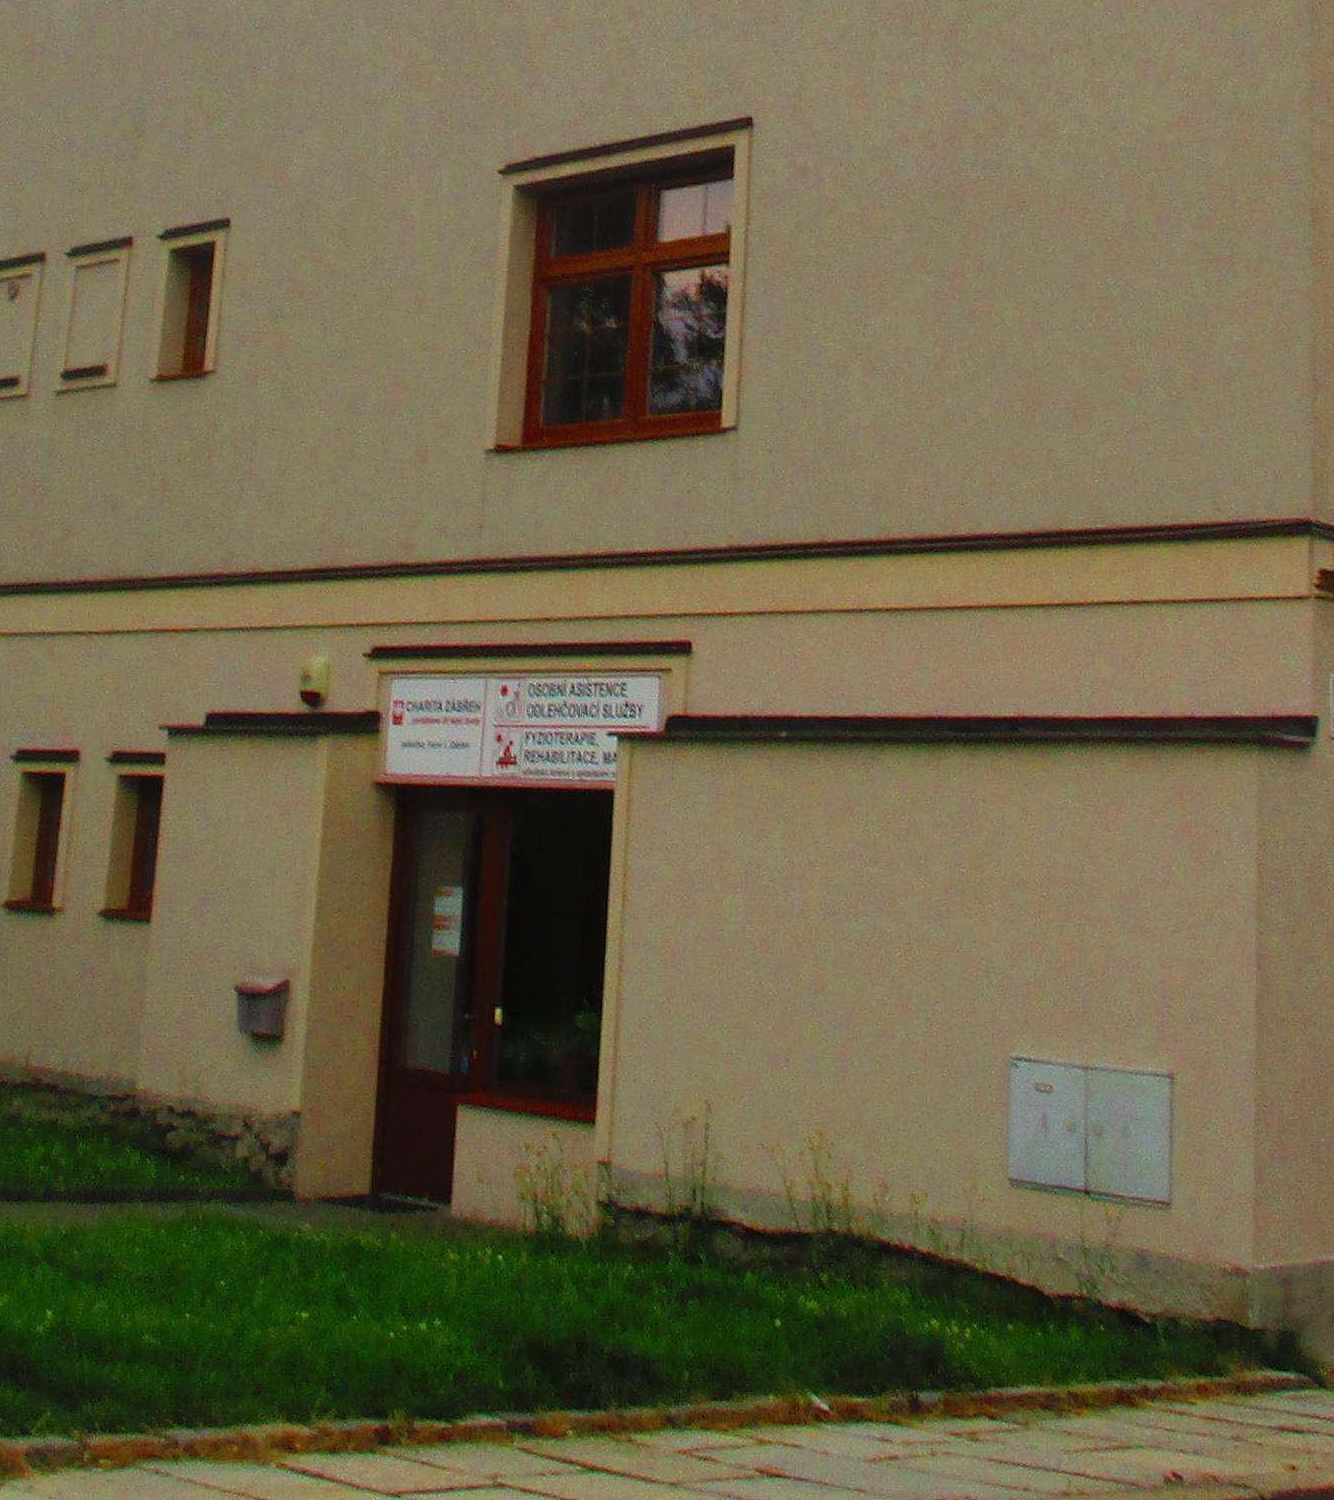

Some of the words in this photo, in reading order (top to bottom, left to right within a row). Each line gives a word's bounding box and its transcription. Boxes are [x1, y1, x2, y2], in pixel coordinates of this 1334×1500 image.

[527, 680, 566, 698] OSOBNÍ
[569, 681, 628, 698] ASISTENCE
[406, 700, 443, 713] CHARITA
[526, 700, 600, 719] ODLEHČOVACÍ
[602, 701, 645, 719] SLUŽBY
